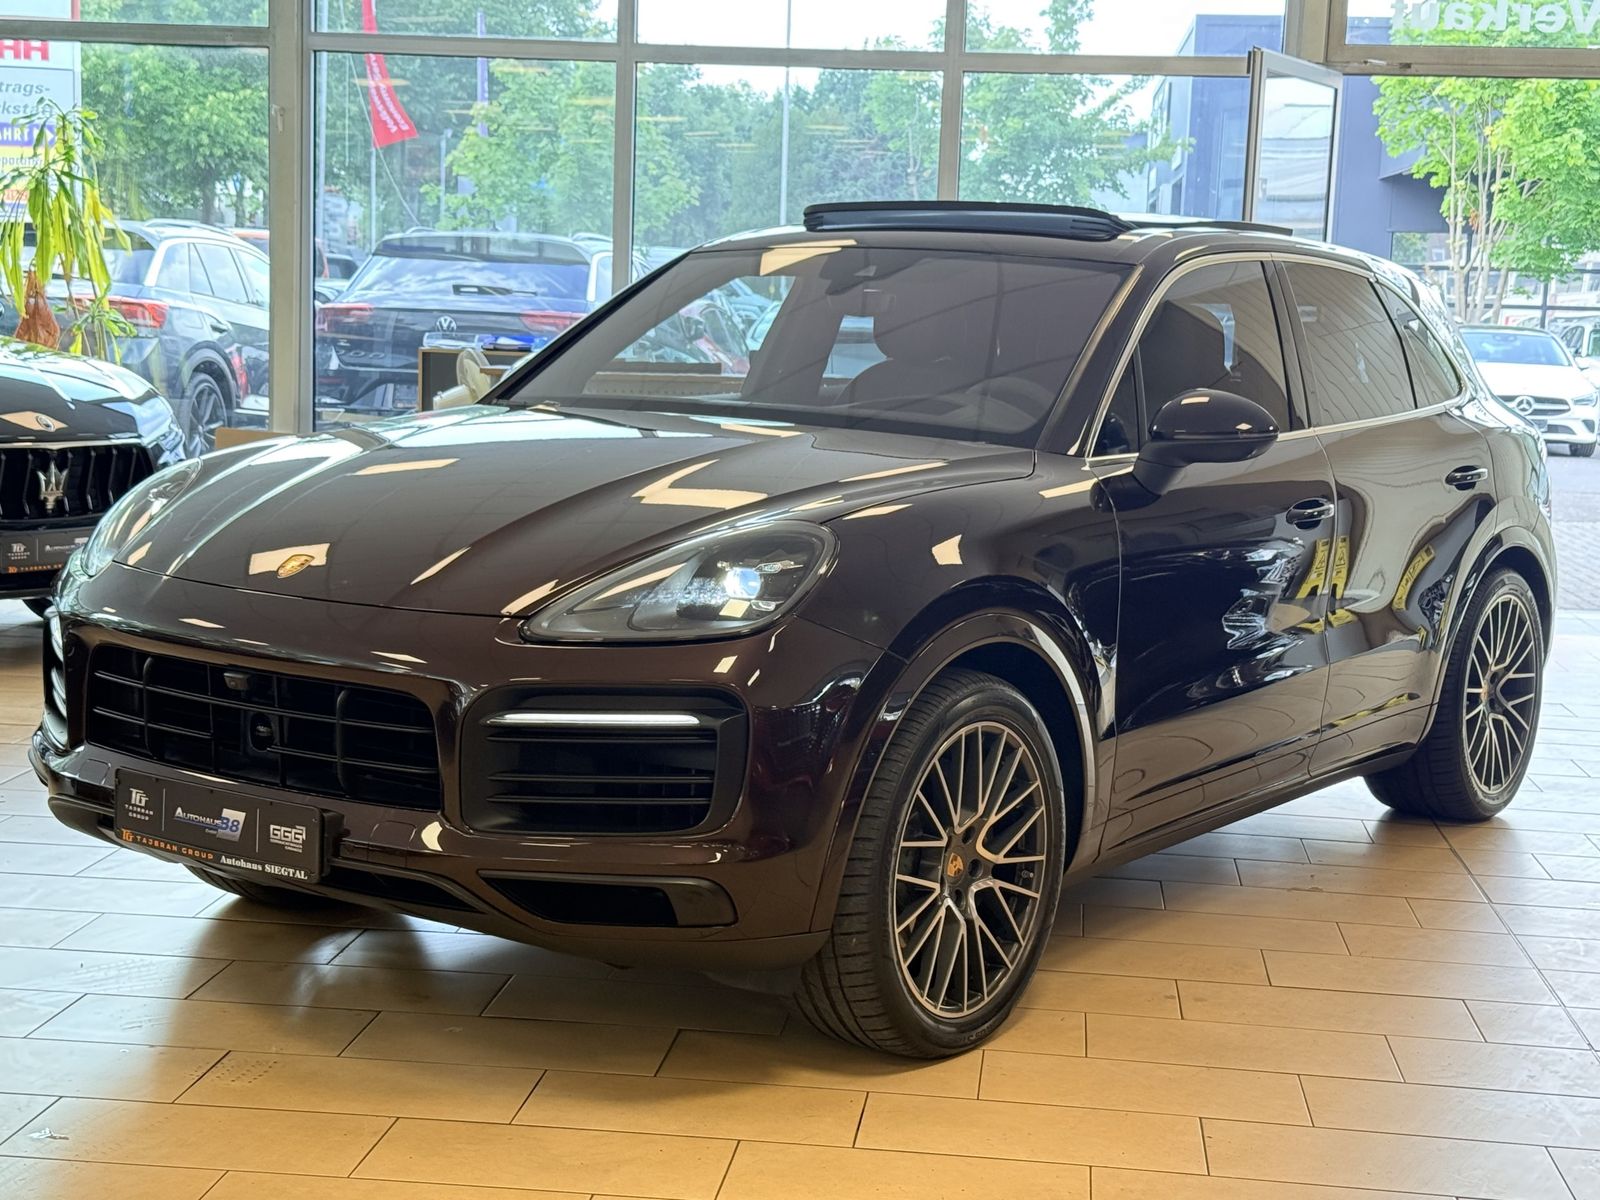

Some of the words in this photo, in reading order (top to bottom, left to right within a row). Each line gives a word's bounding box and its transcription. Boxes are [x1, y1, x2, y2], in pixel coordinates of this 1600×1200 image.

[269, 824, 305, 845] GGG
[182, 847, 214, 860] GROUP
[220, 855, 262, 871] Autohaus
[264, 863, 308, 880] SIEGTAL
